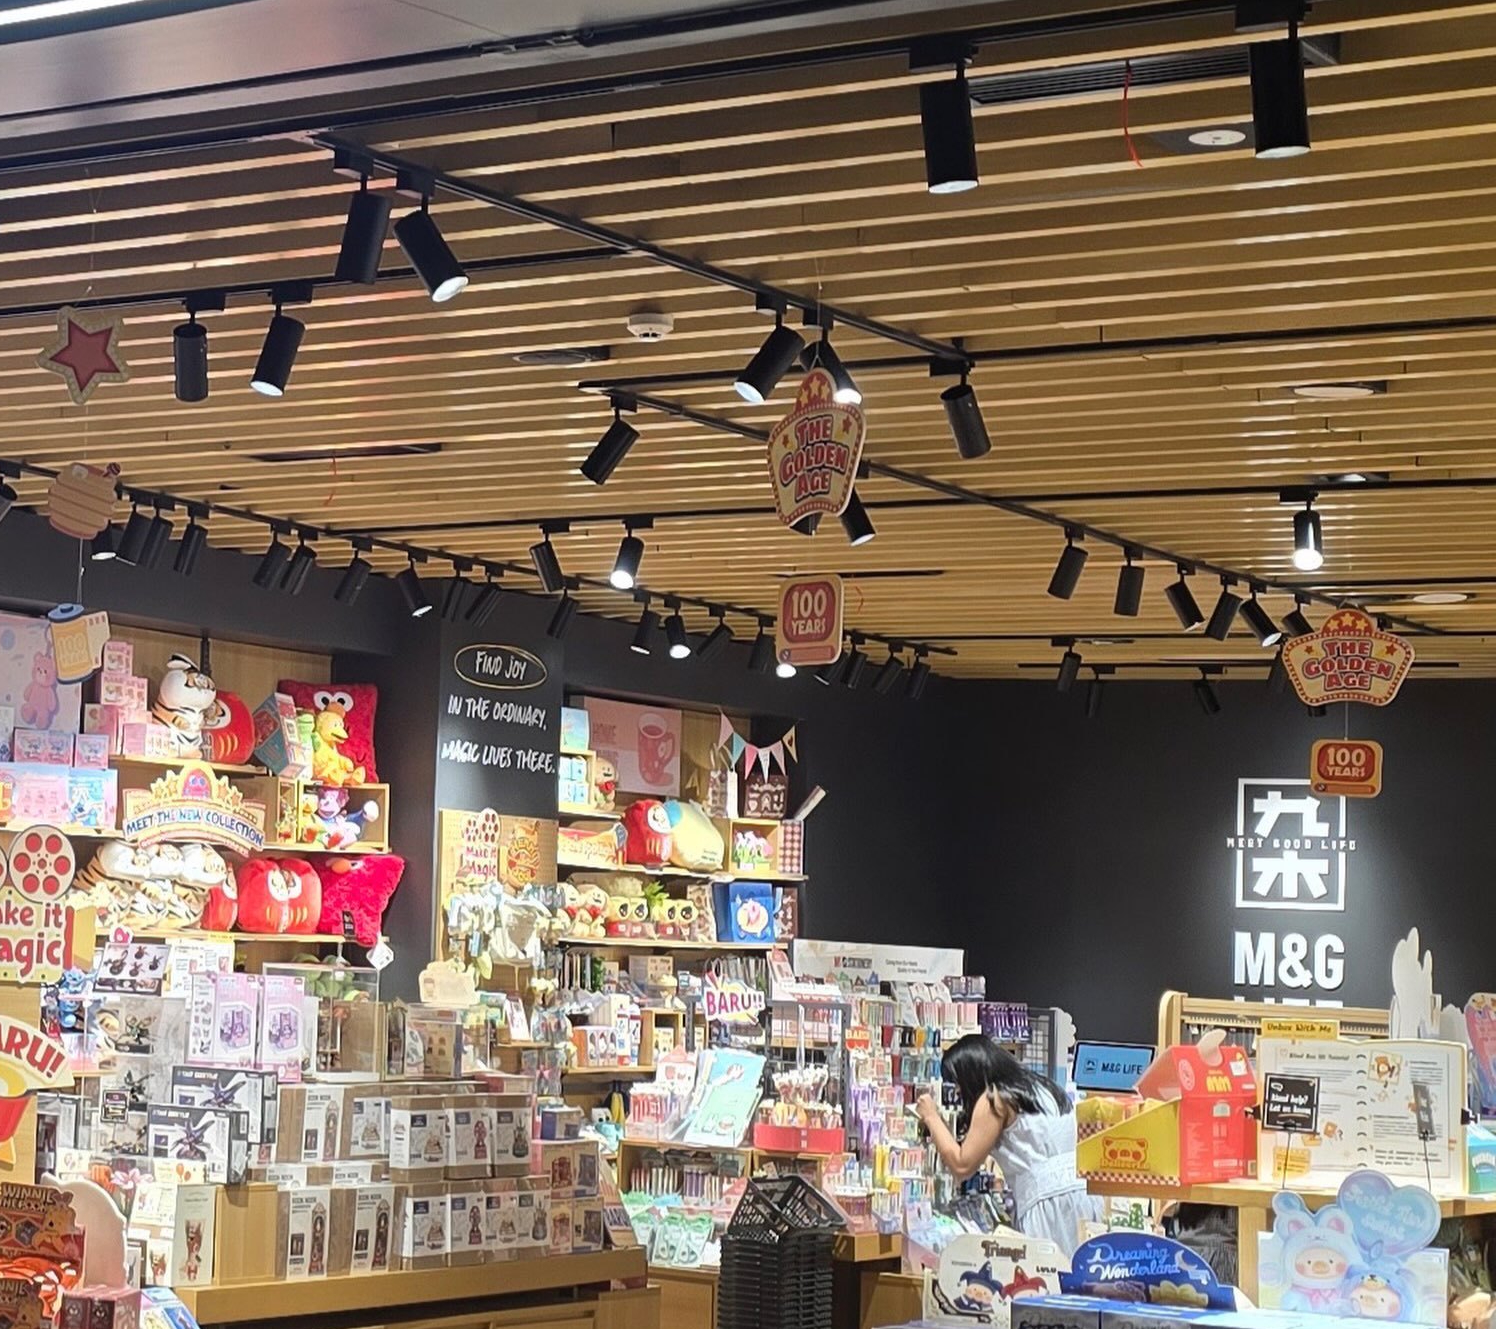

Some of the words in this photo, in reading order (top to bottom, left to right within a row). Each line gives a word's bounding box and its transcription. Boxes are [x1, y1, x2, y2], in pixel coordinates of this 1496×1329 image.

[795, 415, 833, 442] THE
[780, 443, 849, 485] GOLDEN
[794, 470, 832, 502] AGE
[792, 589, 826, 617] 100
[791, 619, 826, 636] YEARS
[1322, 638, 1374, 657] THE
[474, 649, 503, 676] FIND
[1304, 656, 1395, 681] GOLDEN
[1325, 673, 1373, 691] AGE
[448, 694, 462, 716] IN
[465, 698, 490, 720] THE
[492, 704, 548, 731] ORDINARY,
[441, 740, 480, 763] MAGIC
[482, 745, 513, 769] LIVES
[515, 749, 556, 775] THERE.
[1326, 748, 1366, 767] 100
[1326, 766, 1366, 778] YEARS
[125, 814, 154, 836] MEET
[205, 809, 265, 847] COLLECTION
[43, 901, 64, 927] it
[1234, 931, 1345, 990] M&G
[706, 988, 765, 1018] BARU!!
[1267, 1023, 1293, 1033] Unbox
[1295, 1023, 1316, 1033] With
[1319, 1024, 1332, 1033] Me
[1101, 1062, 1121, 1073] M&G
[1123, 1063, 1143, 1074] LIFE
[3, 1183, 54, 1203] WINNIE
[1086, 1241, 1170, 1265] Dreaming
[1035, 1265, 1057, 1274] LULU
[1088, 1260, 1181, 1281] Wonderland
